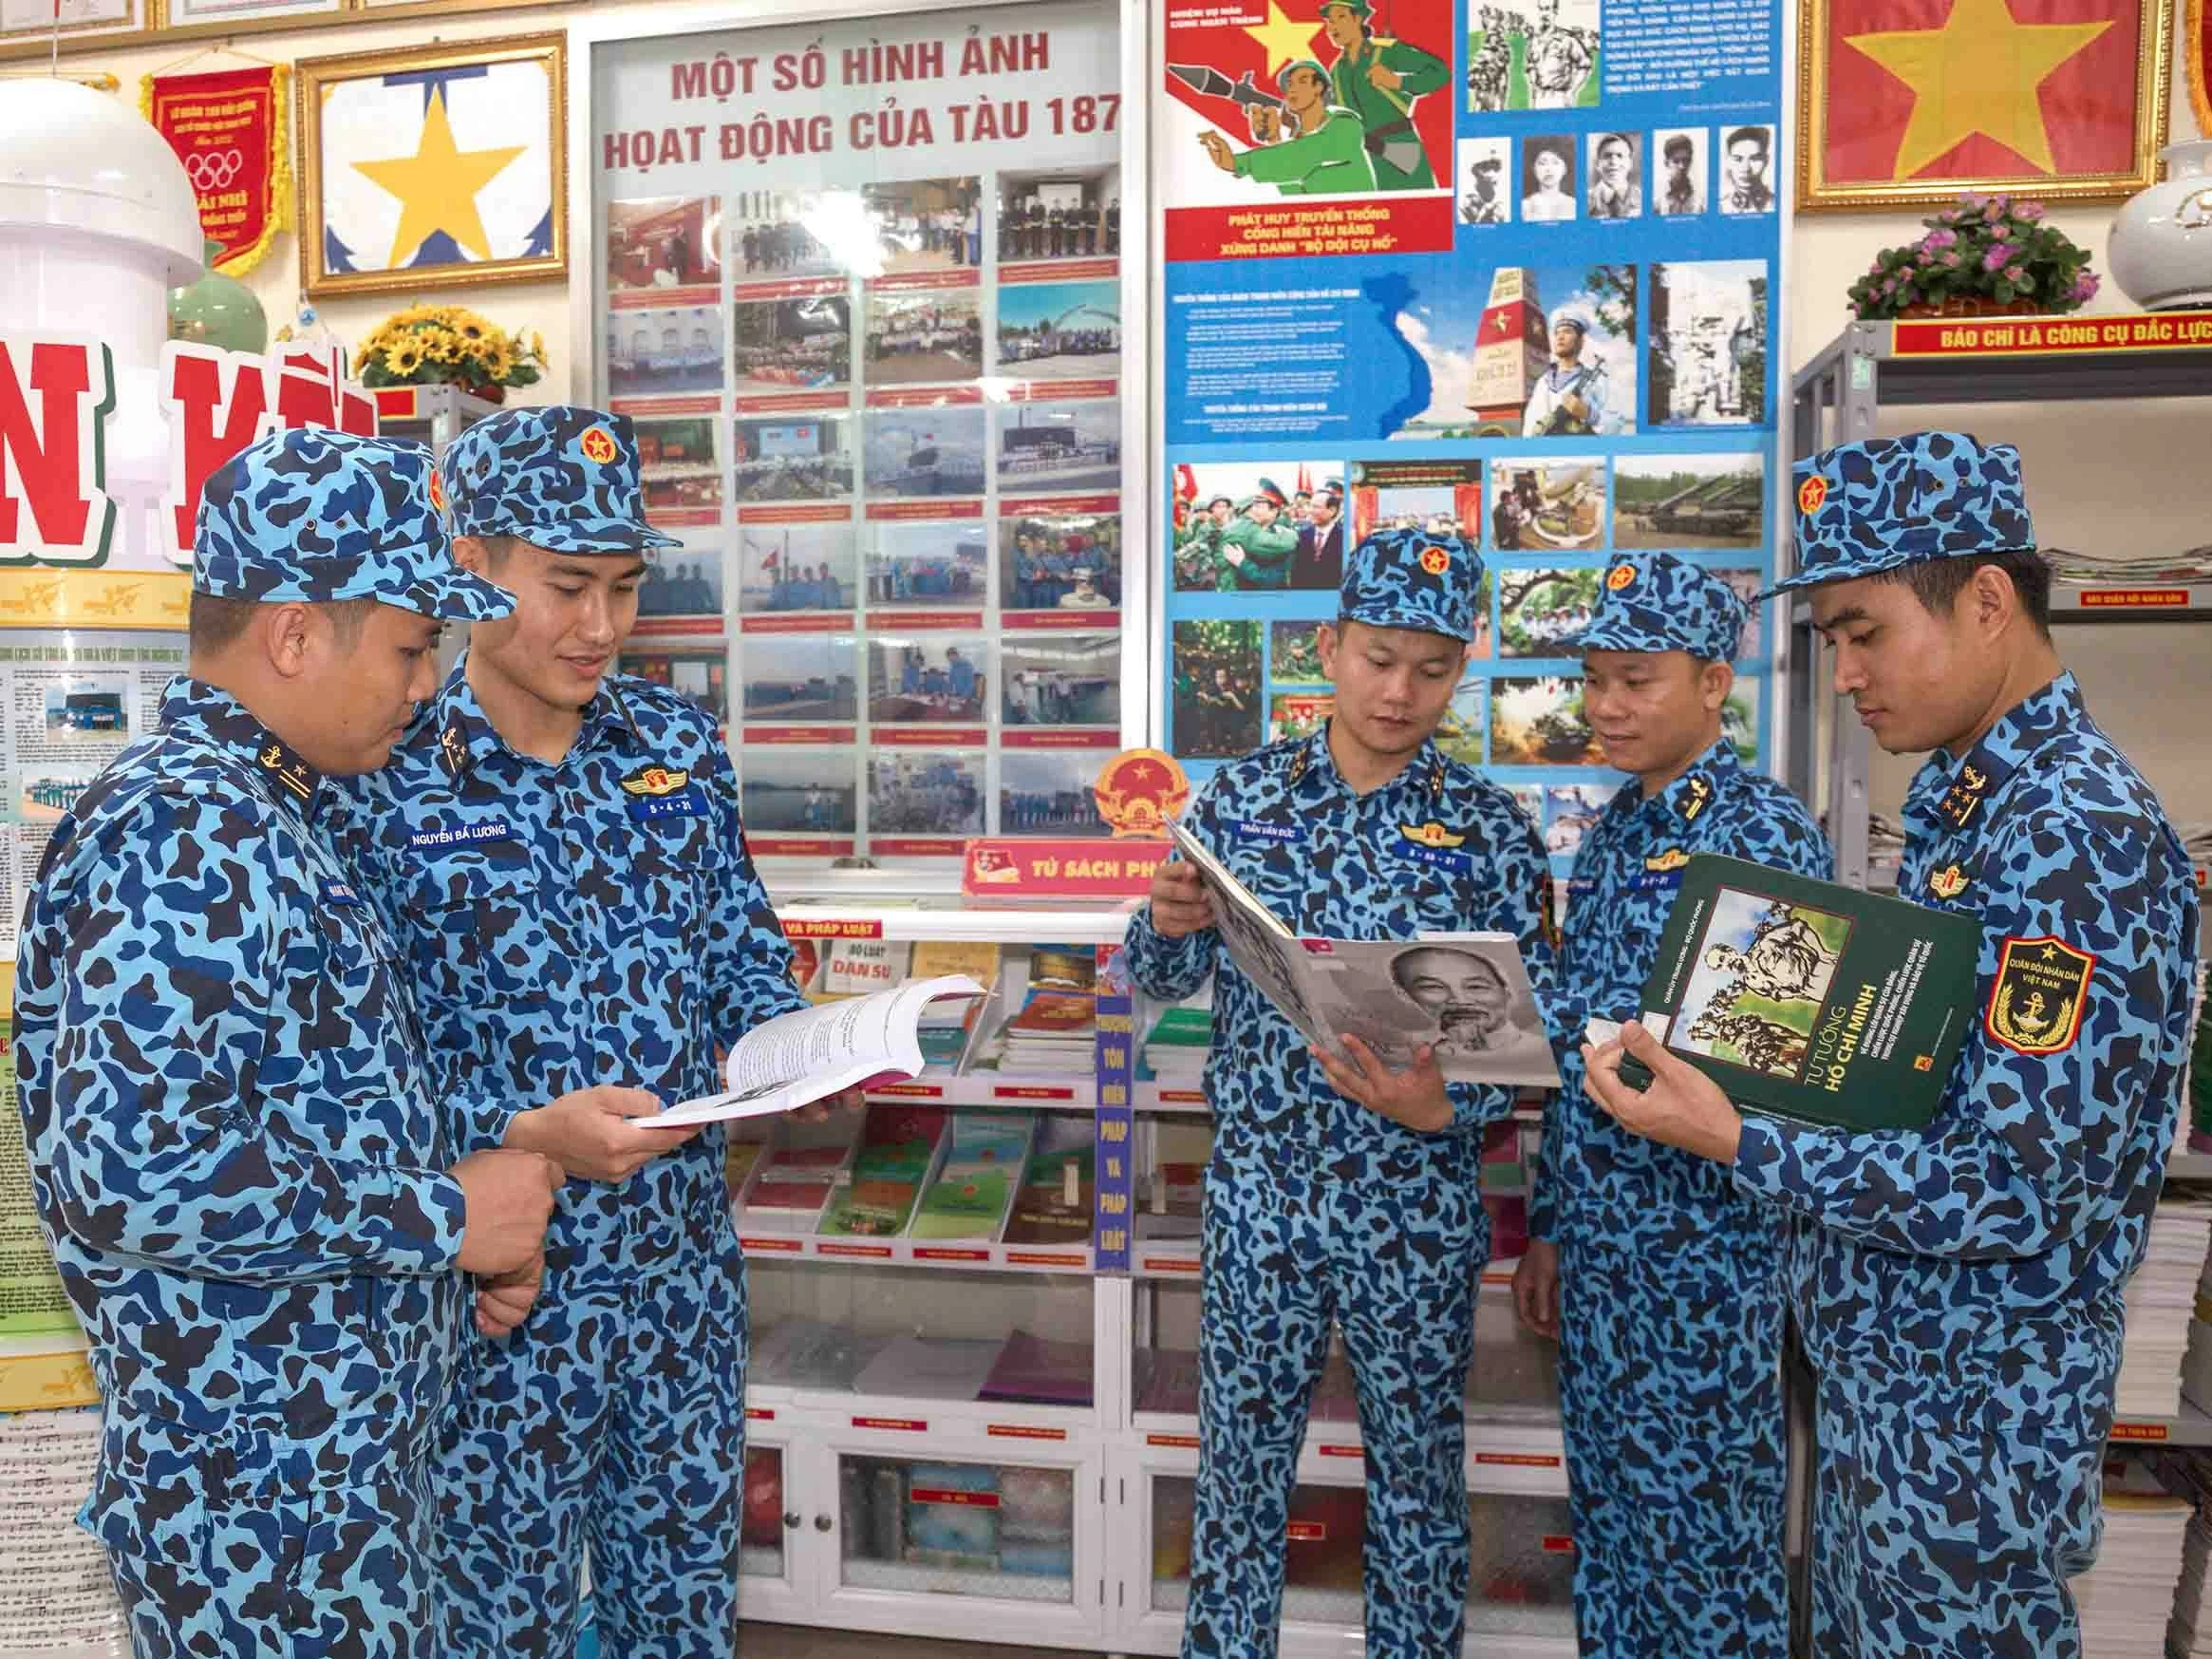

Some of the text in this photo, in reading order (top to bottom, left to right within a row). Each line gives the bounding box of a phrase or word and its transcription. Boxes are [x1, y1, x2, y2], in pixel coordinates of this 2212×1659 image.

[671, 24, 1050, 101] MỘT SỐ HÌNH ẢNH
[718, 112, 833, 163] ĐỘNG
[848, 97, 934, 150] CỦA
[947, 93, 1030, 142] TÀU
[1045, 93, 1121, 135] 187
[1264, 212, 1291, 225] HUY
[1259, 241, 1296, 255] DANH
[1940, 318, 2212, 348] BÁO CHÍ LÀ CÔNG CỤ ĐẮC LỰC
[411, 823, 507, 846] NGUYỄN BÁ LƯƠNG
[1032, 857, 1155, 878] TỦ SÁCH PH
[806, 920, 841, 934] PHÁP
[842, 922, 874, 936] LUẬT
[2009, 958, 2081, 982] QUÂN ĐỘI NHÂN DÂN
[2022, 972, 2061, 989] VIỆT NAM
[1846, 983, 1877, 1031] MINH
[1803, 1006, 1846, 1084] TƯ TƯỞNG
[1835, 1029, 1858, 1061] CHÍ
